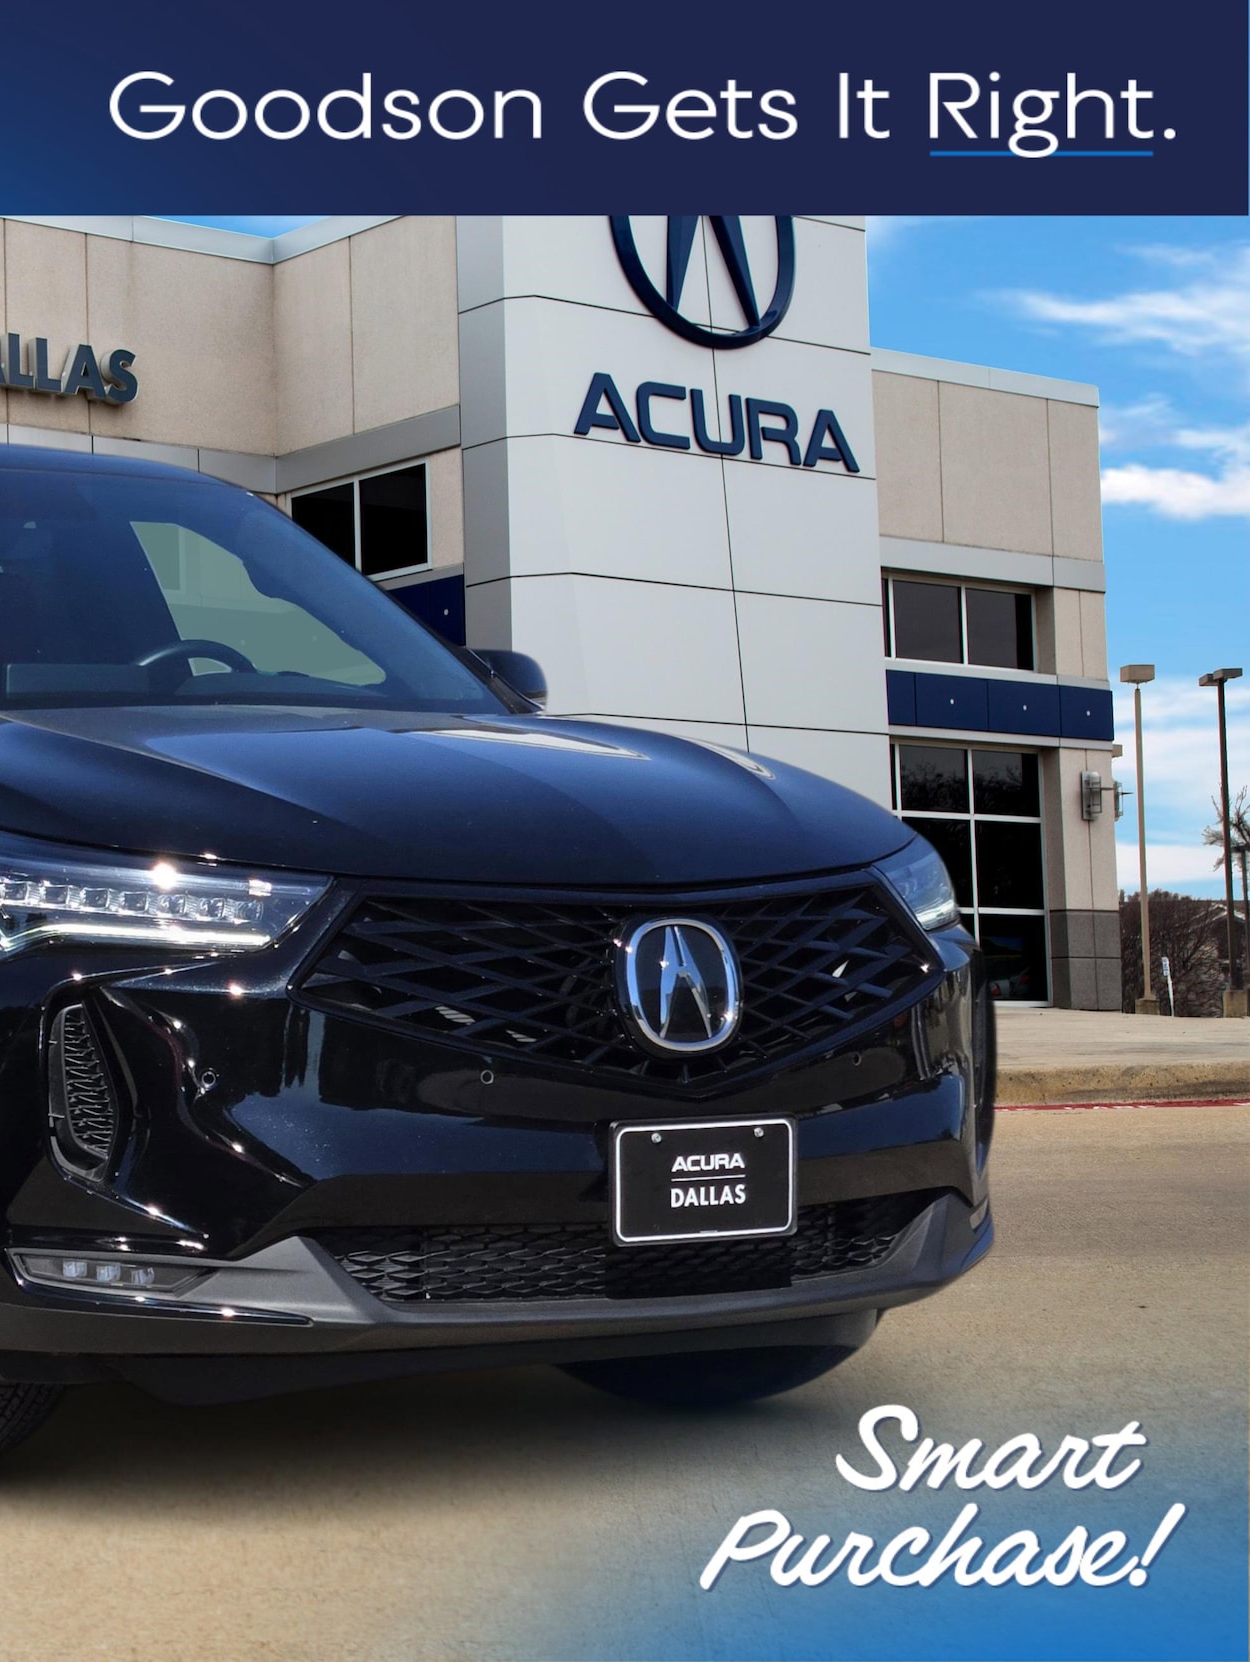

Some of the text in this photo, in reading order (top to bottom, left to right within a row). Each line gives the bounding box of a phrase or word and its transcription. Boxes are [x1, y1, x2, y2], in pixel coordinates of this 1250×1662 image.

[573, 372, 860, 473] ACURA
[671, 1152, 746, 1173] ACURA
[670, 1183, 747, 1209] DALLAS
